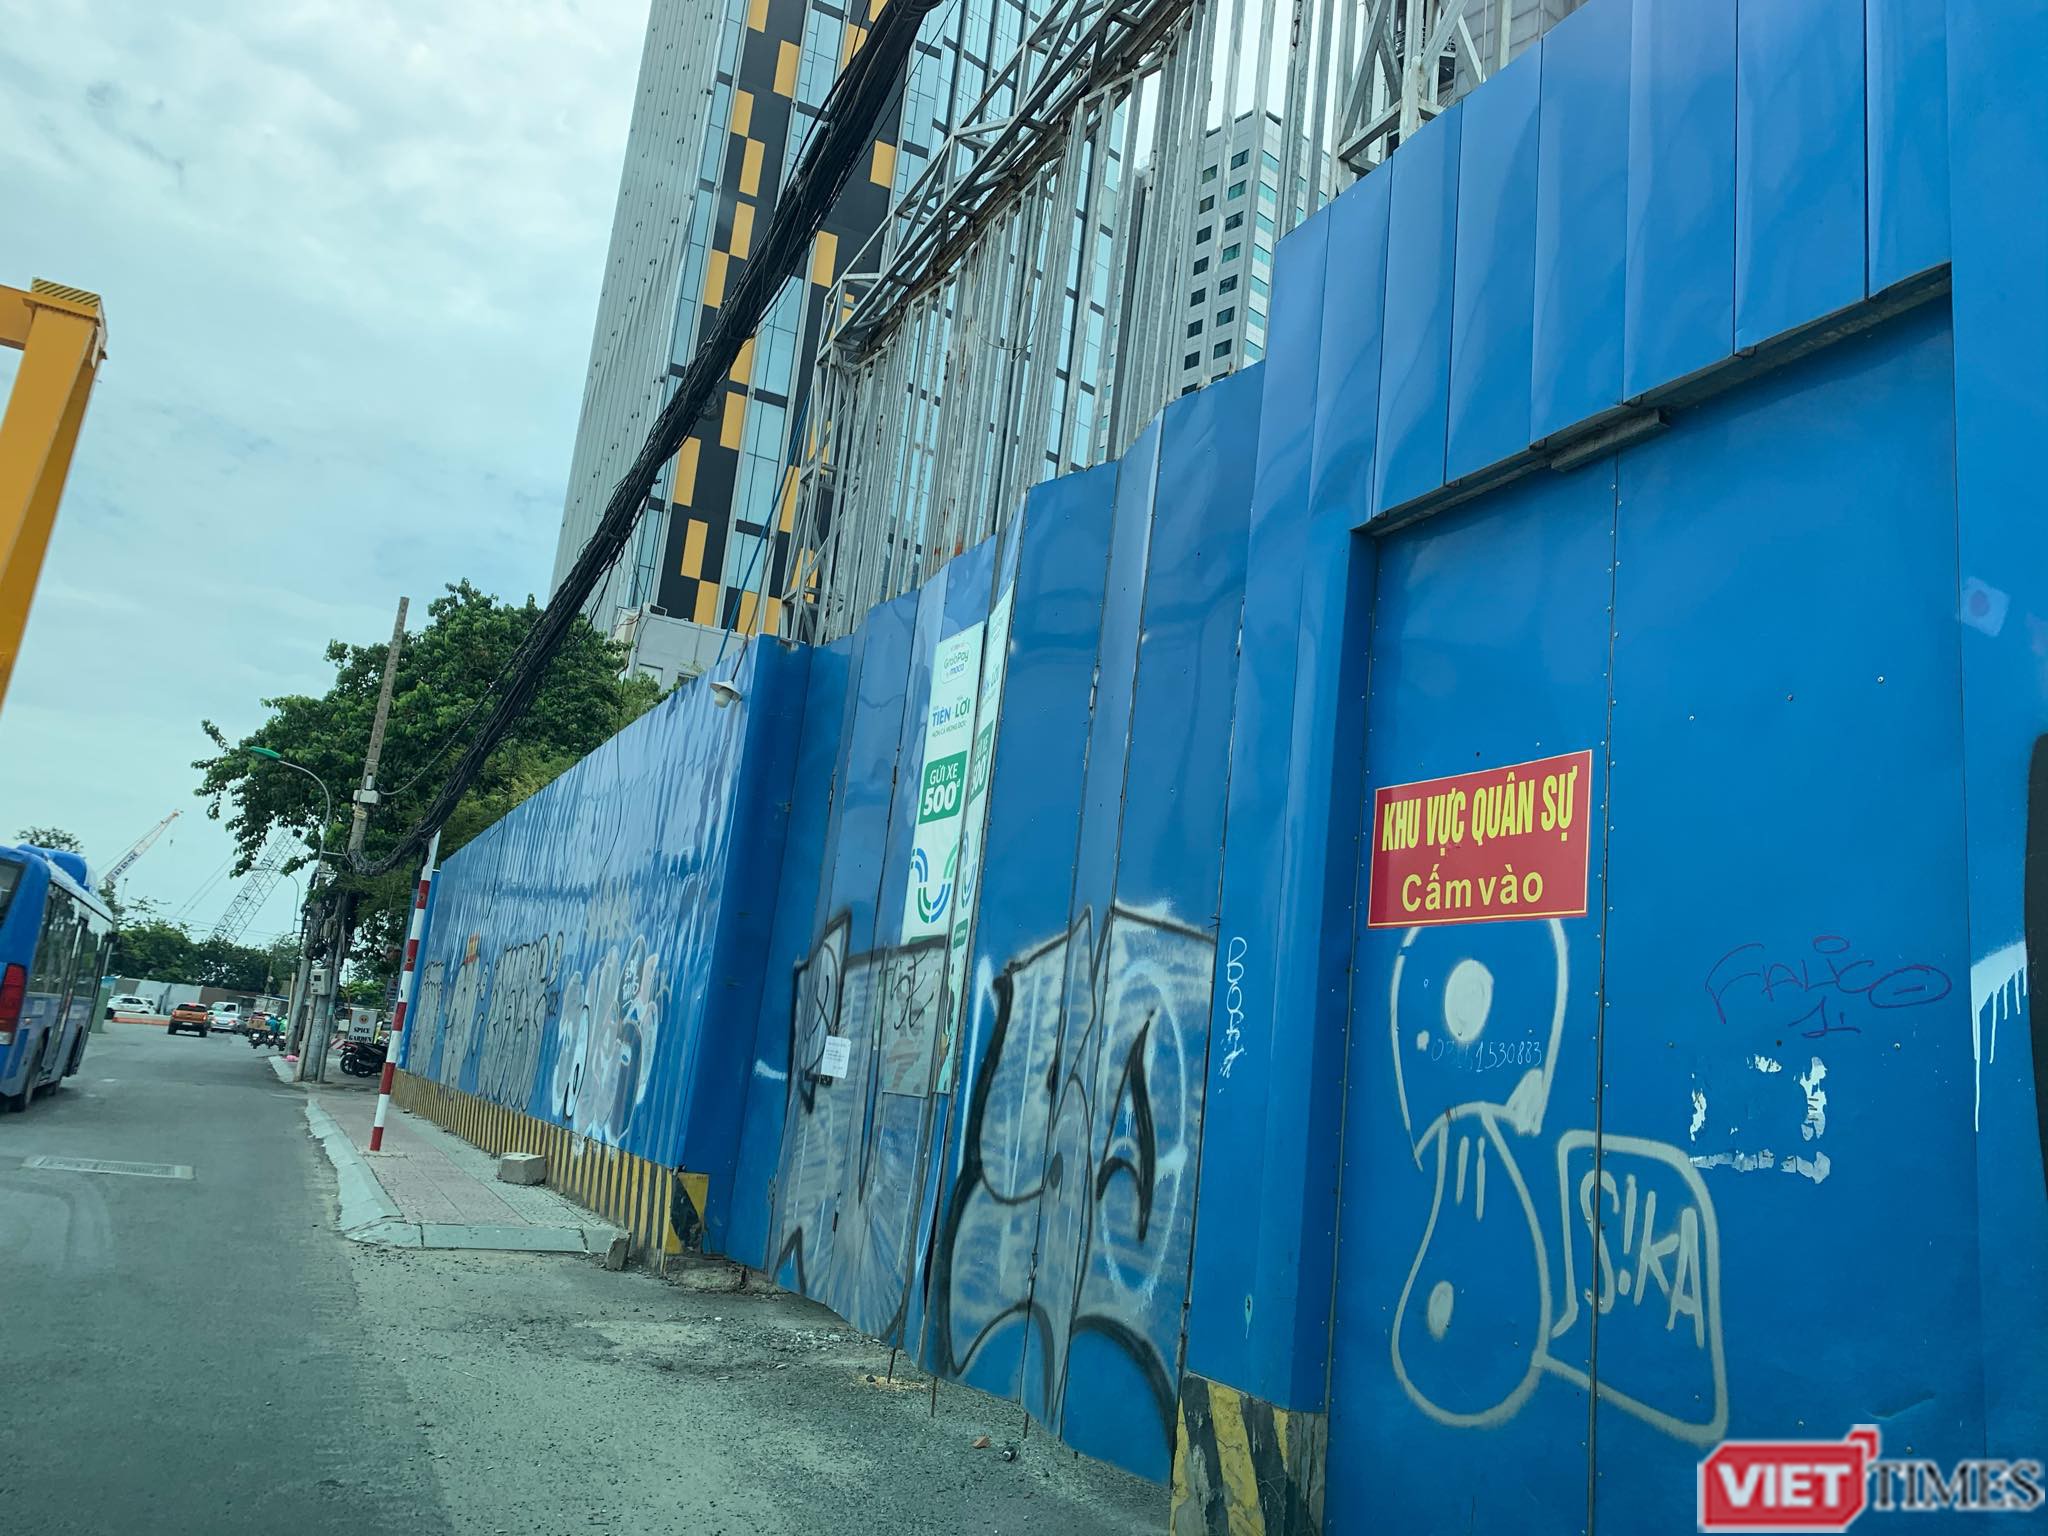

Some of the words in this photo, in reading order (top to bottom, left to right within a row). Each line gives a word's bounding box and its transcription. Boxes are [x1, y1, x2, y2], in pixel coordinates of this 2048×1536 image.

[946, 762, 958, 780] XE
[1382, 798, 1421, 852] KHU
[1426, 788, 1466, 857] VỰC
[1471, 771, 1536, 847] QUÂN
[1541, 765, 1578, 842] SỰ
[1402, 863, 1472, 912] Cấm
[1478, 863, 1543, 906] vào
